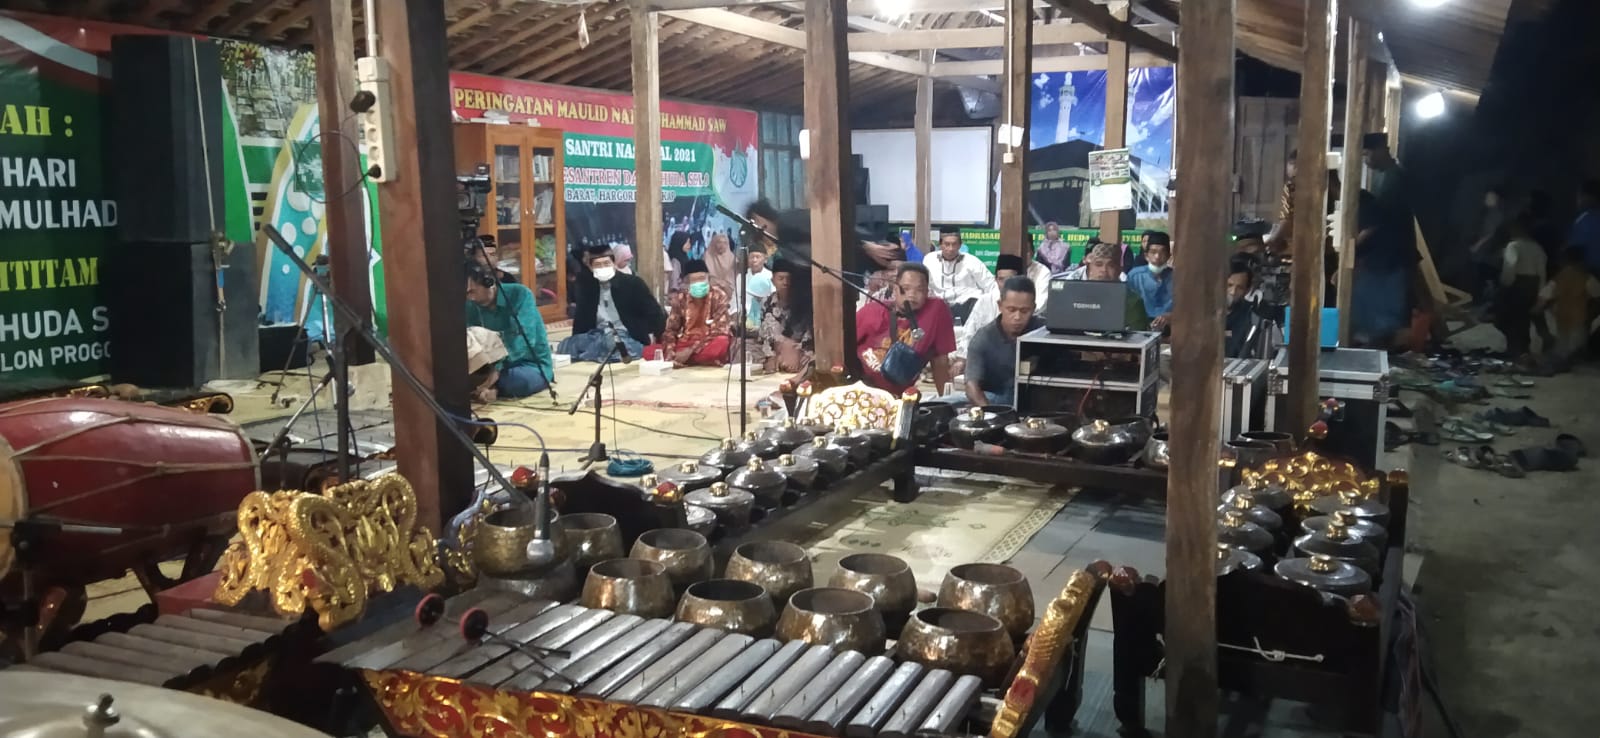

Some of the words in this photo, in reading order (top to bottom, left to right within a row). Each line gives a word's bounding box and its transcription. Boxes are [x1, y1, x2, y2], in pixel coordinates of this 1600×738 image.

[454, 88, 553, 116] PERINGATAN
[557, 99, 608, 122] MAULID
[660, 112, 705, 132] HAMMAD
[707, 117, 727, 133] SAW
[565, 139, 613, 158] SANTRI
[674, 148, 696, 163] 2021
[0, 157, 76, 188] HARI
[0, 308, 84, 341] HUDA
